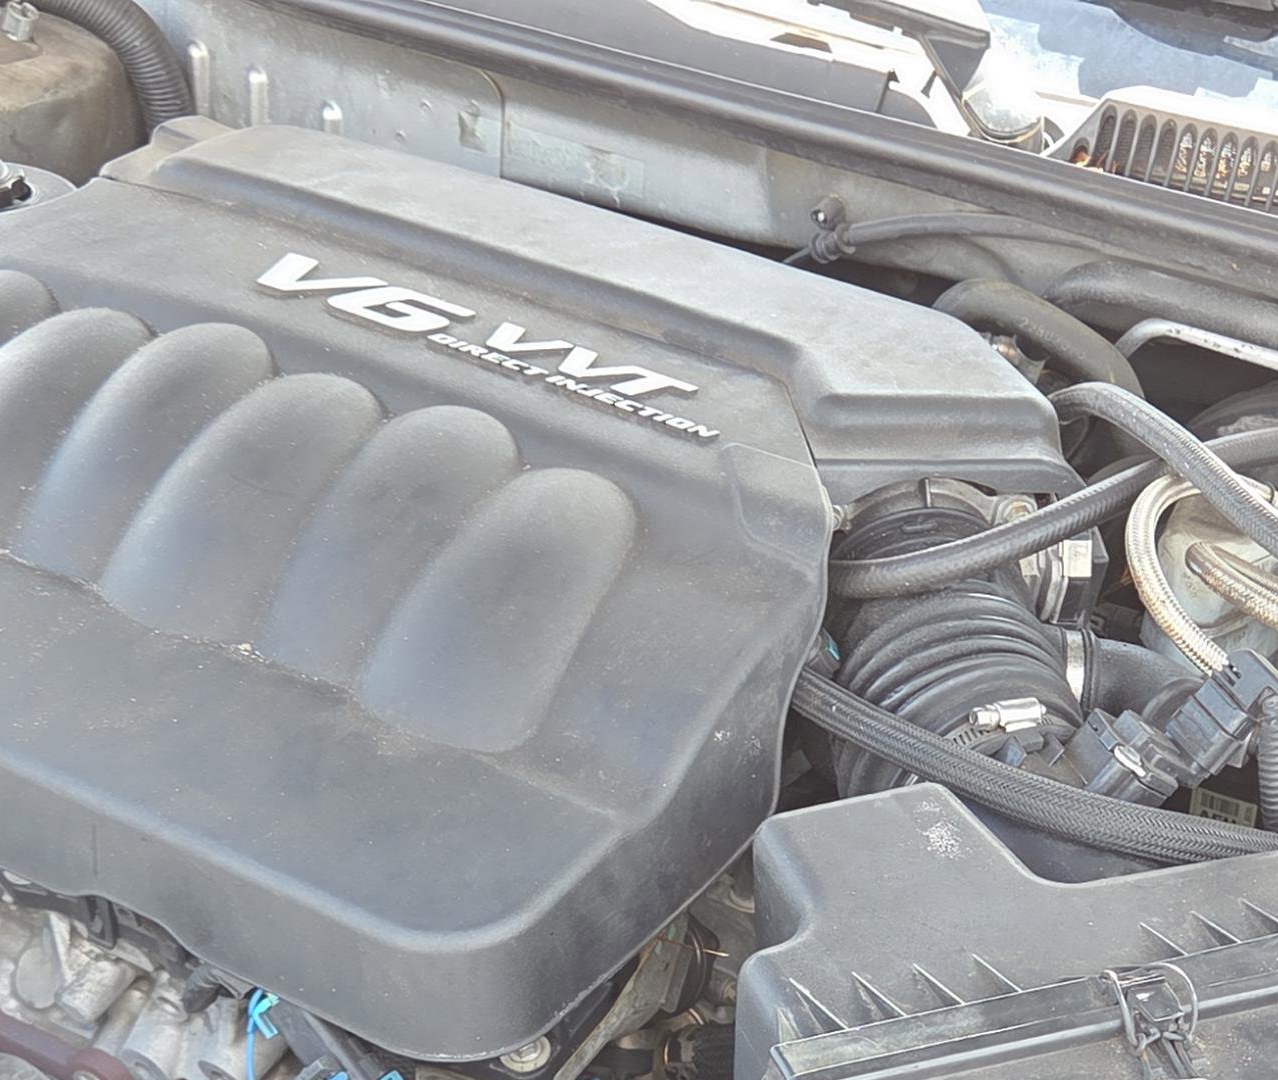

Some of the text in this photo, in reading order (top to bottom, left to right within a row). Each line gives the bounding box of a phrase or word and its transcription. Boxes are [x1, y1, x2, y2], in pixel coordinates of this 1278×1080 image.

[255, 251, 700, 397] V6 VVT
[426, 332, 721, 440] DIRECT INJECTION
